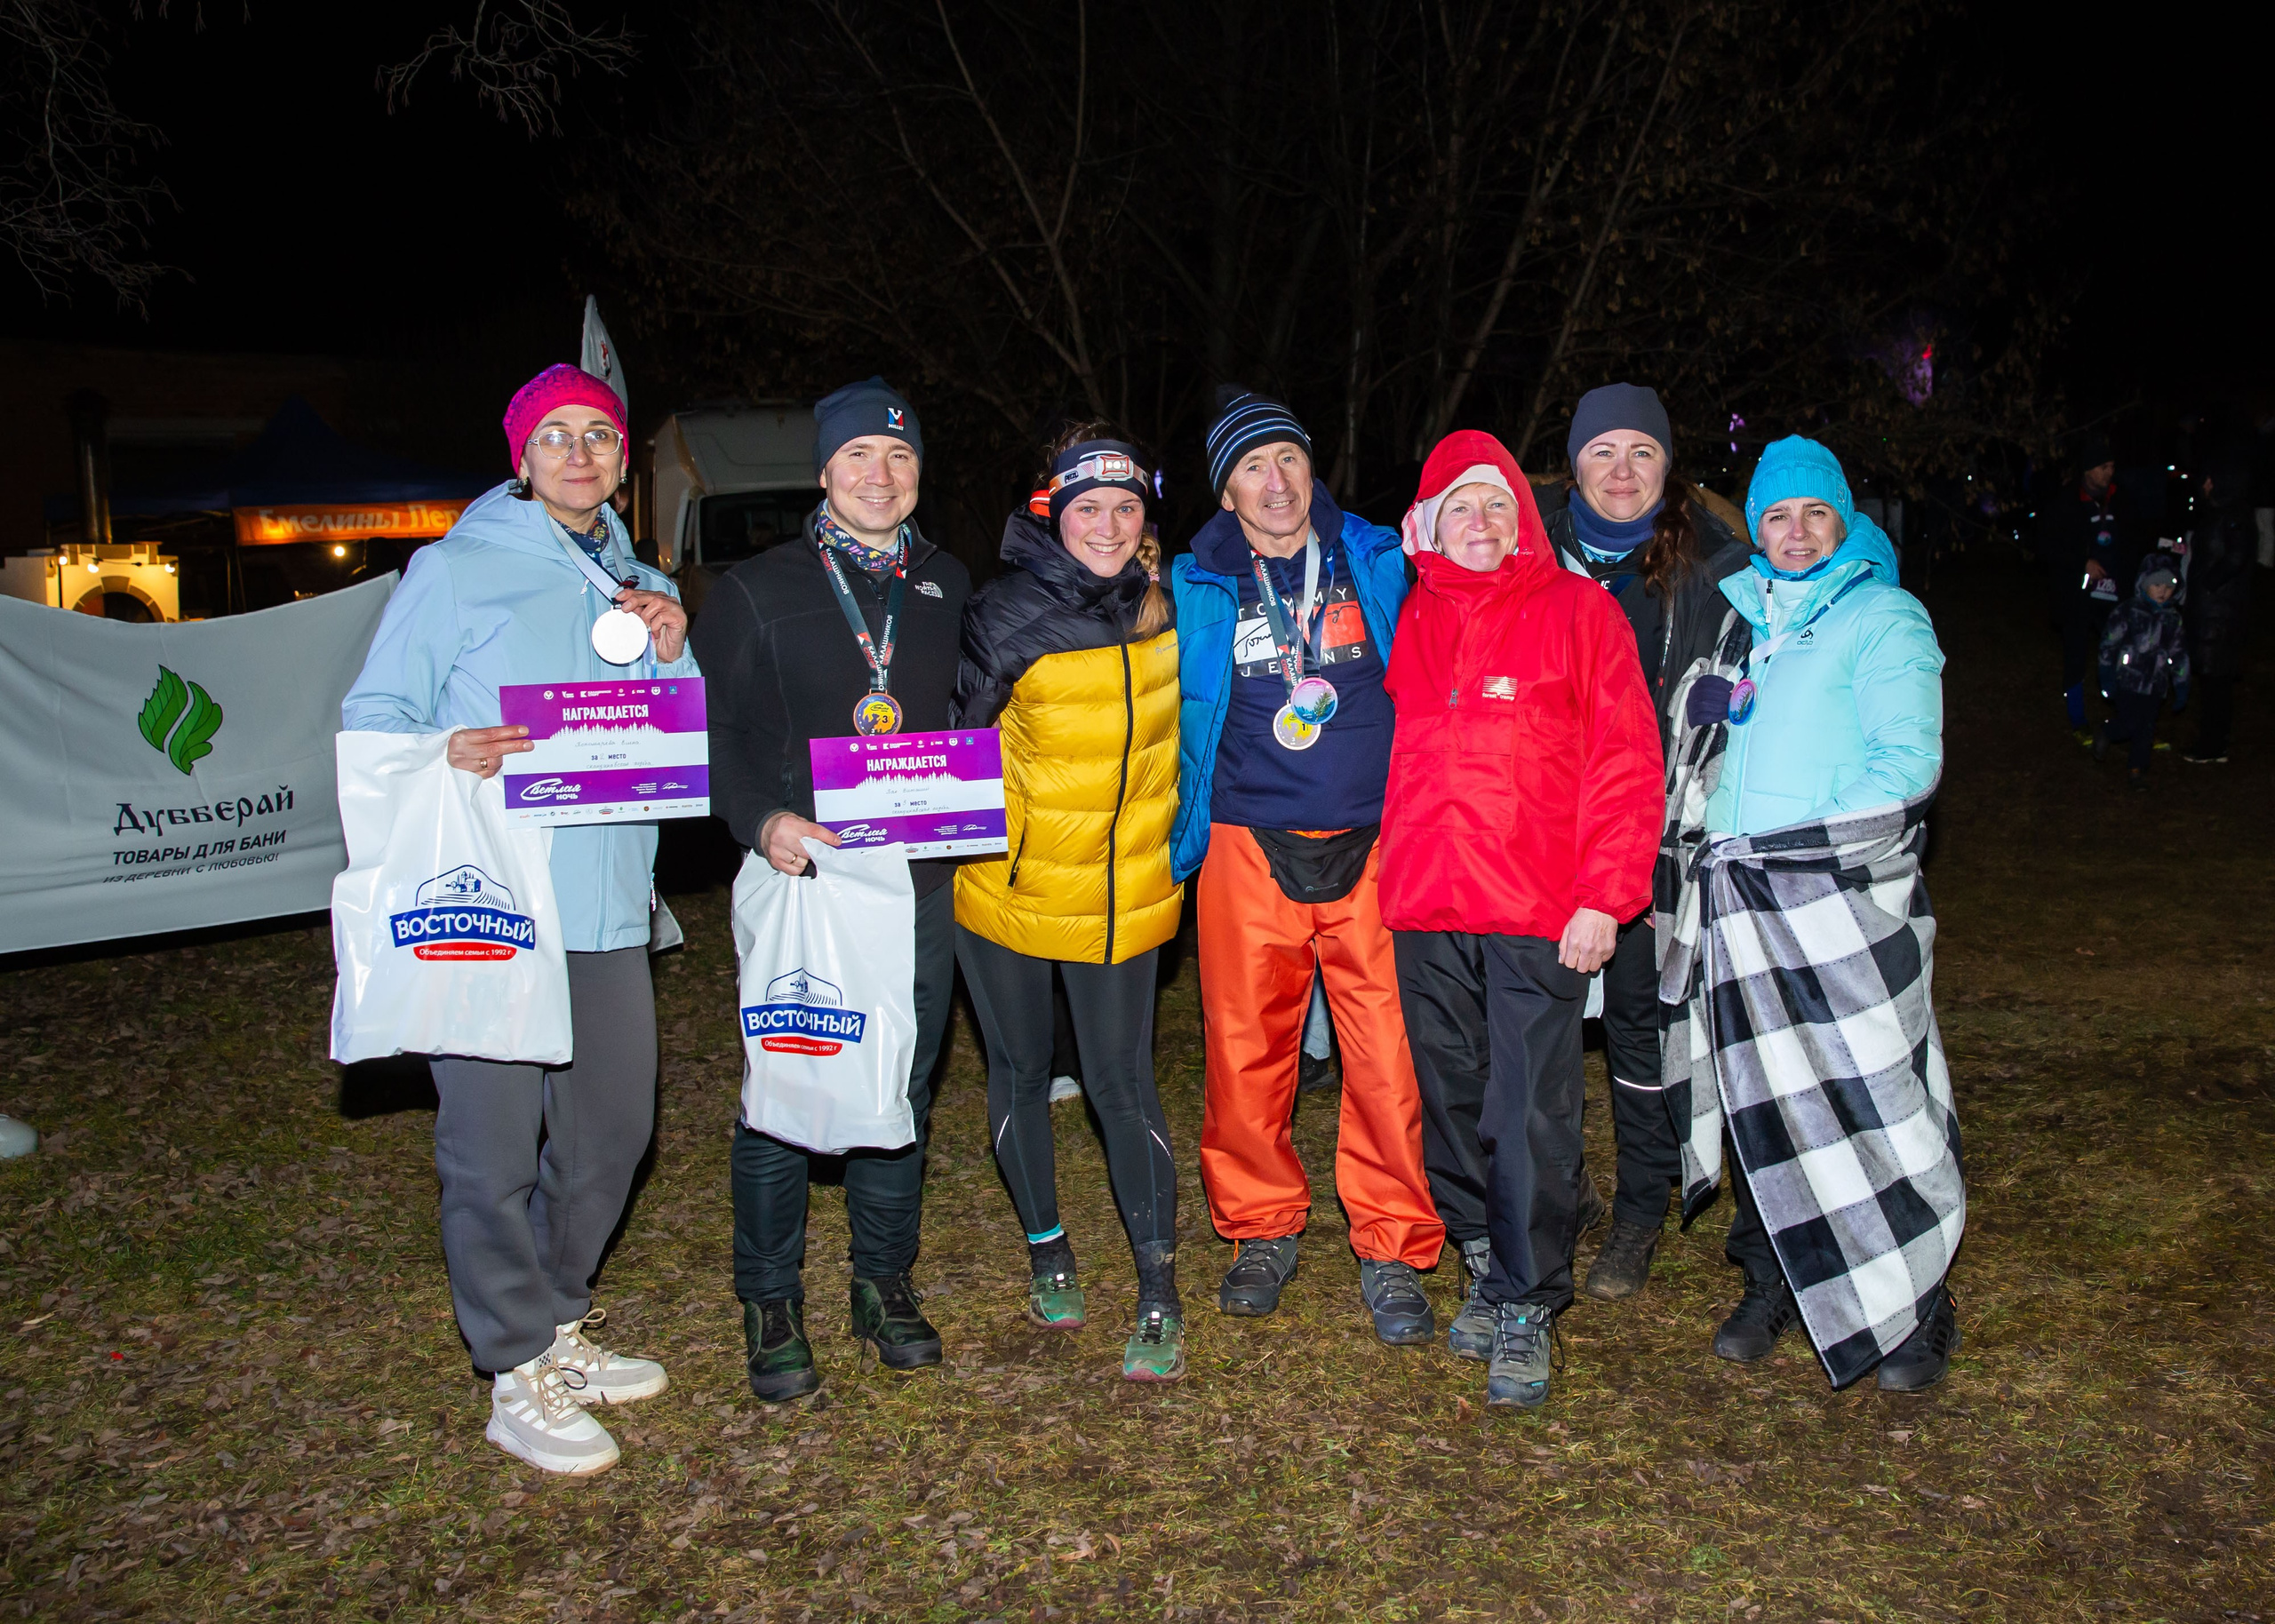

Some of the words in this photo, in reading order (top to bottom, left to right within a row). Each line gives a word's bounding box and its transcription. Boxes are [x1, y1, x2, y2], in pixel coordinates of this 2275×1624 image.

[259, 509, 400, 534] Емелины
[819, 550, 834, 571] СПОРТ
[825, 547, 850, 595] КАЛАШНИКОВ
[1253, 561, 1264, 581] СПОРТ
[1258, 559, 1276, 606] КАЛАШНИКОВ
[1241, 647, 1362, 677] JENS
[562, 705, 649, 721] НАГРАЖДАЕТСЯ
[866, 754, 947, 772] НАГРАЖДАЕТСЯ
[520, 777, 582, 801] Светлая
[113, 846, 190, 865] ТОВАРЫ
[192, 840, 236, 860] ДЛЯ
[239, 830, 287, 851] БАНИ
[103, 875, 124, 884] ИЗ
[124, 866, 192, 883] ДЕРЕВНИ
[196, 864, 205, 873] С
[208, 853, 280, 872] ЛЮБОВЬЮ!
[395, 912, 535, 943] ВОСТОЧНЫЙ
[746, 1009, 861, 1037] ВОСТОЧНЫЙ
[764, 1039, 801, 1049] Объединяем
